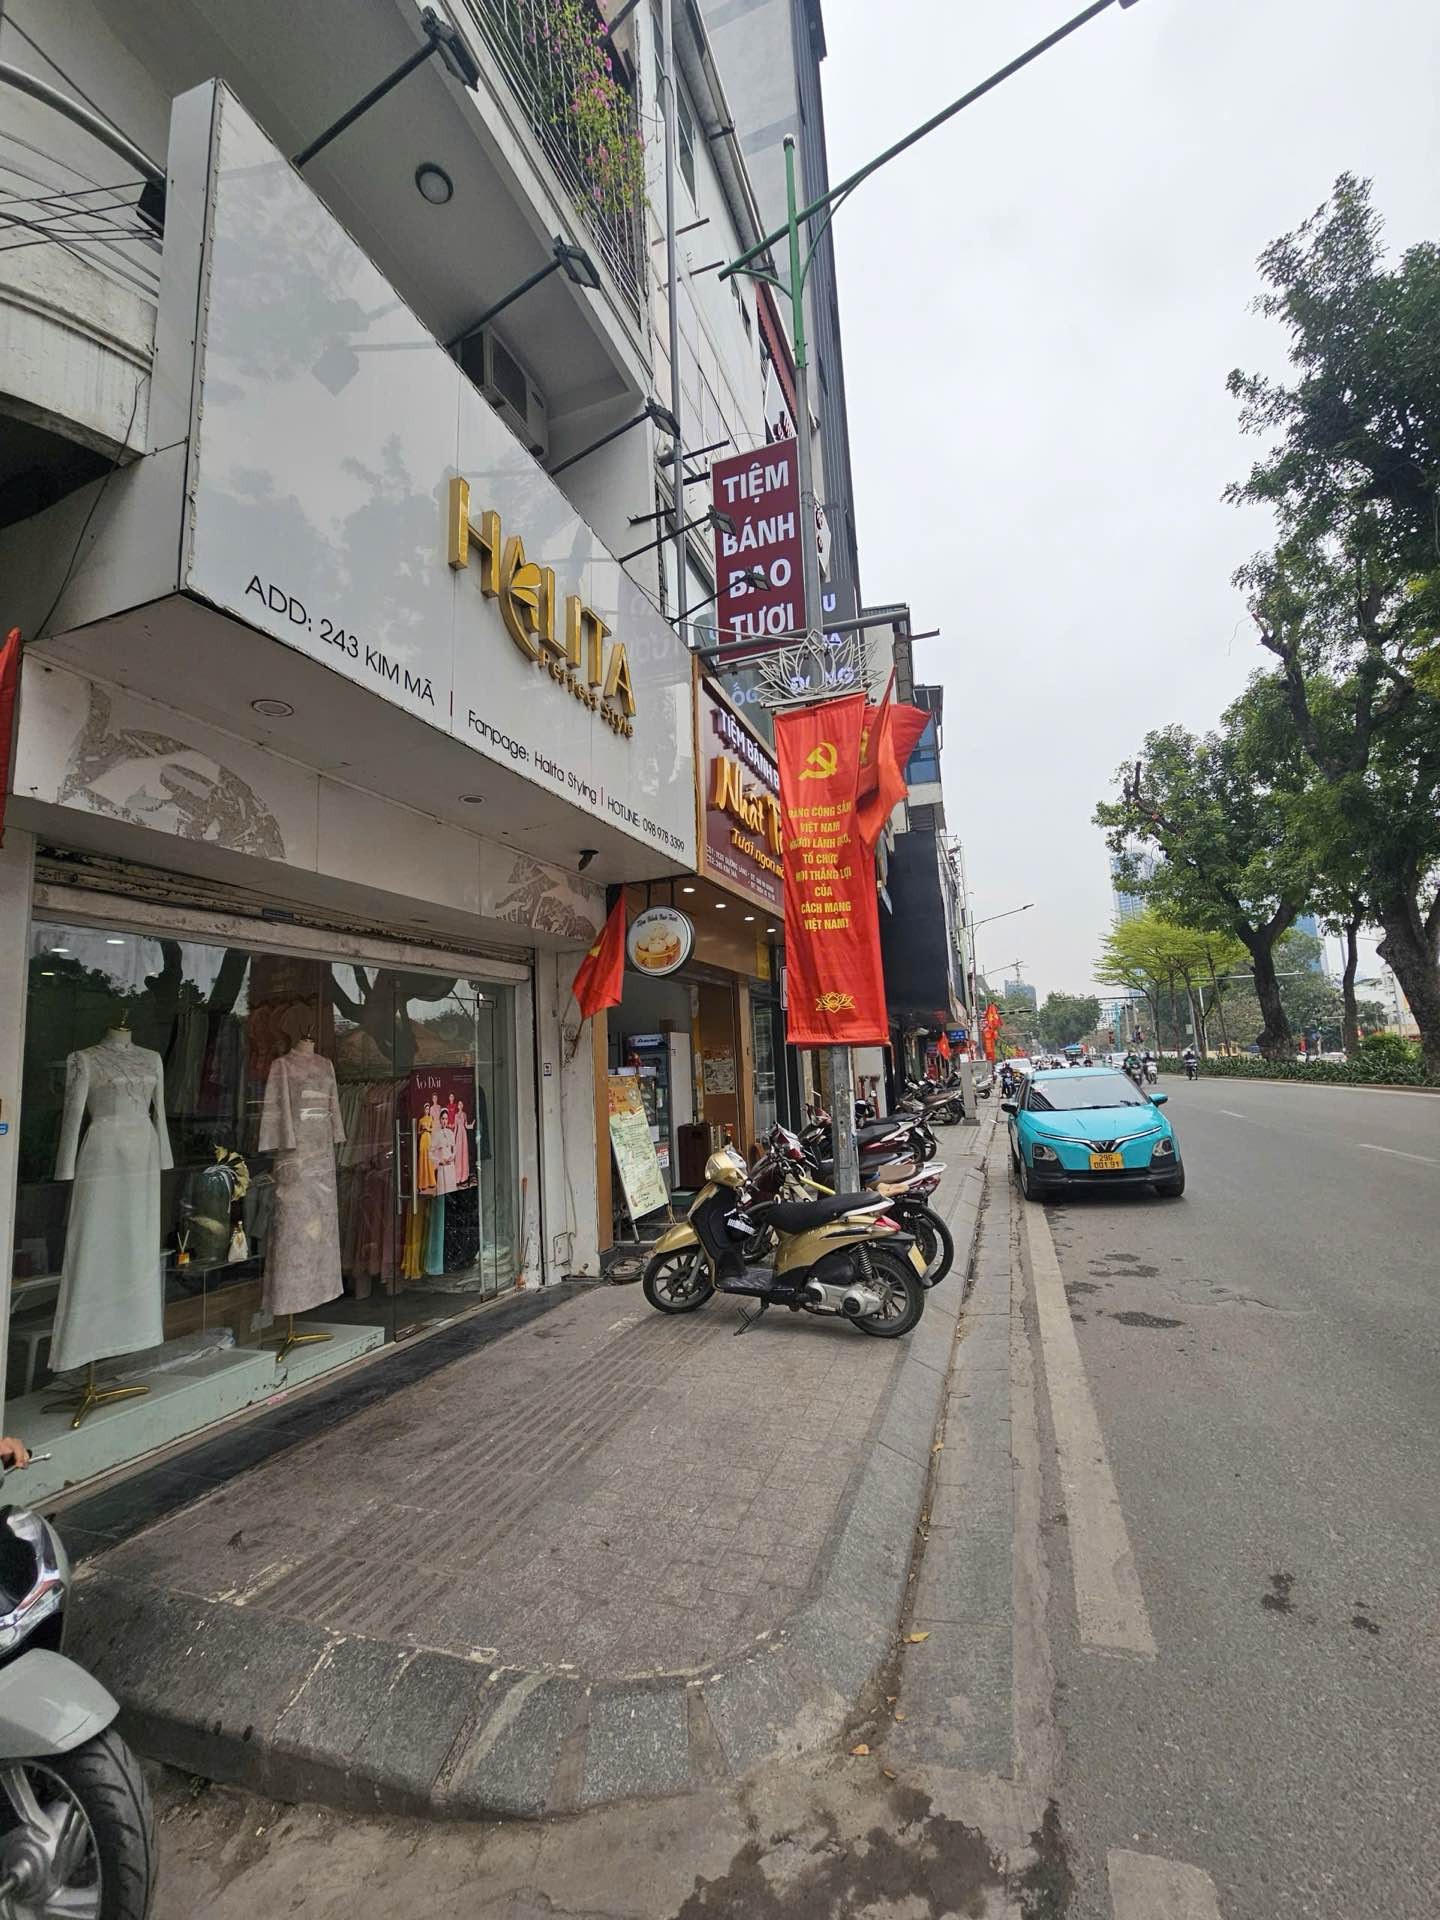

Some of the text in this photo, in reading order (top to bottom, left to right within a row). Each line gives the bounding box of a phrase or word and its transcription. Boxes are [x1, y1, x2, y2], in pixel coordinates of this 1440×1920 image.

[722, 460, 790, 503] TIỆM
[722, 512, 796, 557] BÁNH
[448, 476, 636, 716] HALITA
[245, 575, 312, 632] ADD:
[320, 618, 359, 658] 243
[365, 645, 399, 685] KIM
[730, 602, 795, 643] TƯƠI
[600, 701, 634, 739] Style
[468, 709, 597, 804] Fanpage: Halita Styling
[719, 707, 746, 749] TIỆM
[746, 739, 773, 785] BÁNH
[820, 820, 840, 833] NAM
[804, 917, 822, 931] VIỆT
